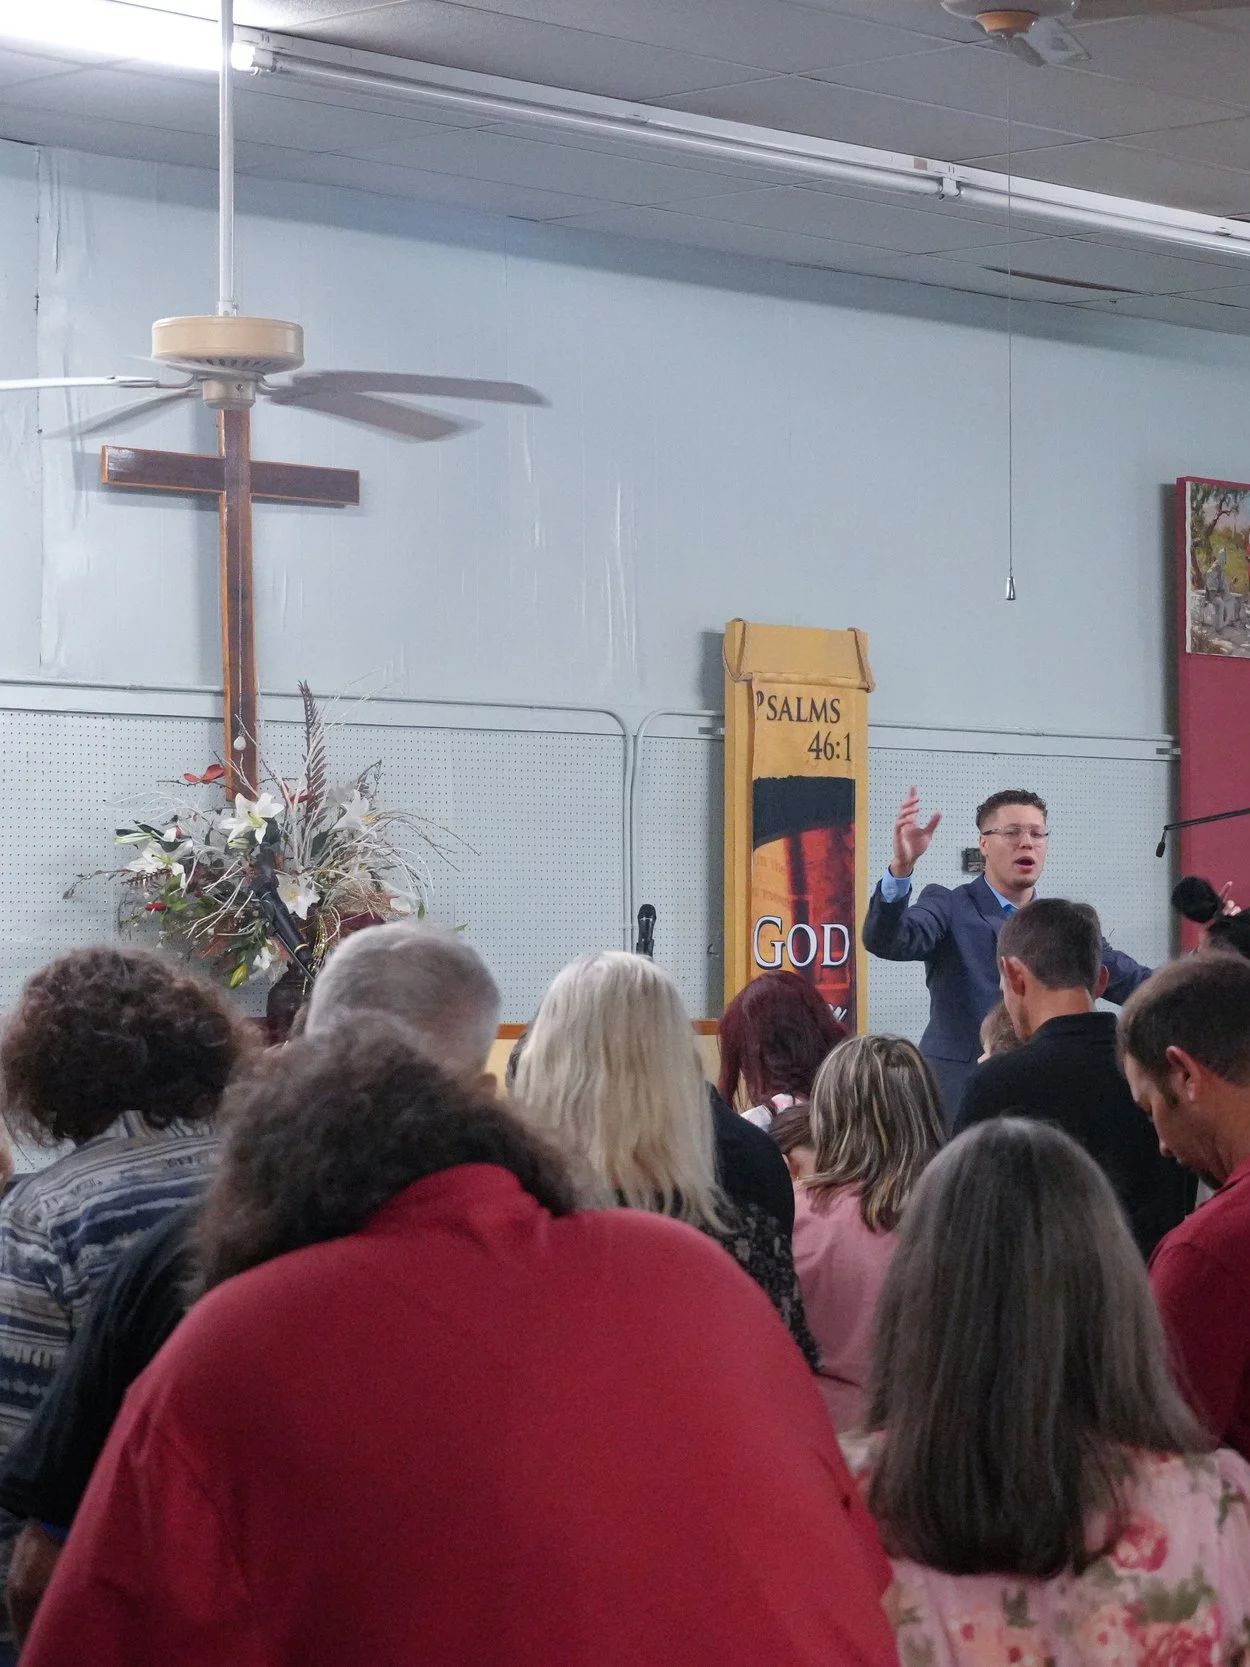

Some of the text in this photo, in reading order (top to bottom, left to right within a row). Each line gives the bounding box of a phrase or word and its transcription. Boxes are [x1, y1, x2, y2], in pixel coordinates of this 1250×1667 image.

[756, 690, 841, 724] PSALMS
[807, 730, 852, 762] 46:1
[753, 915, 850, 969] GOD
